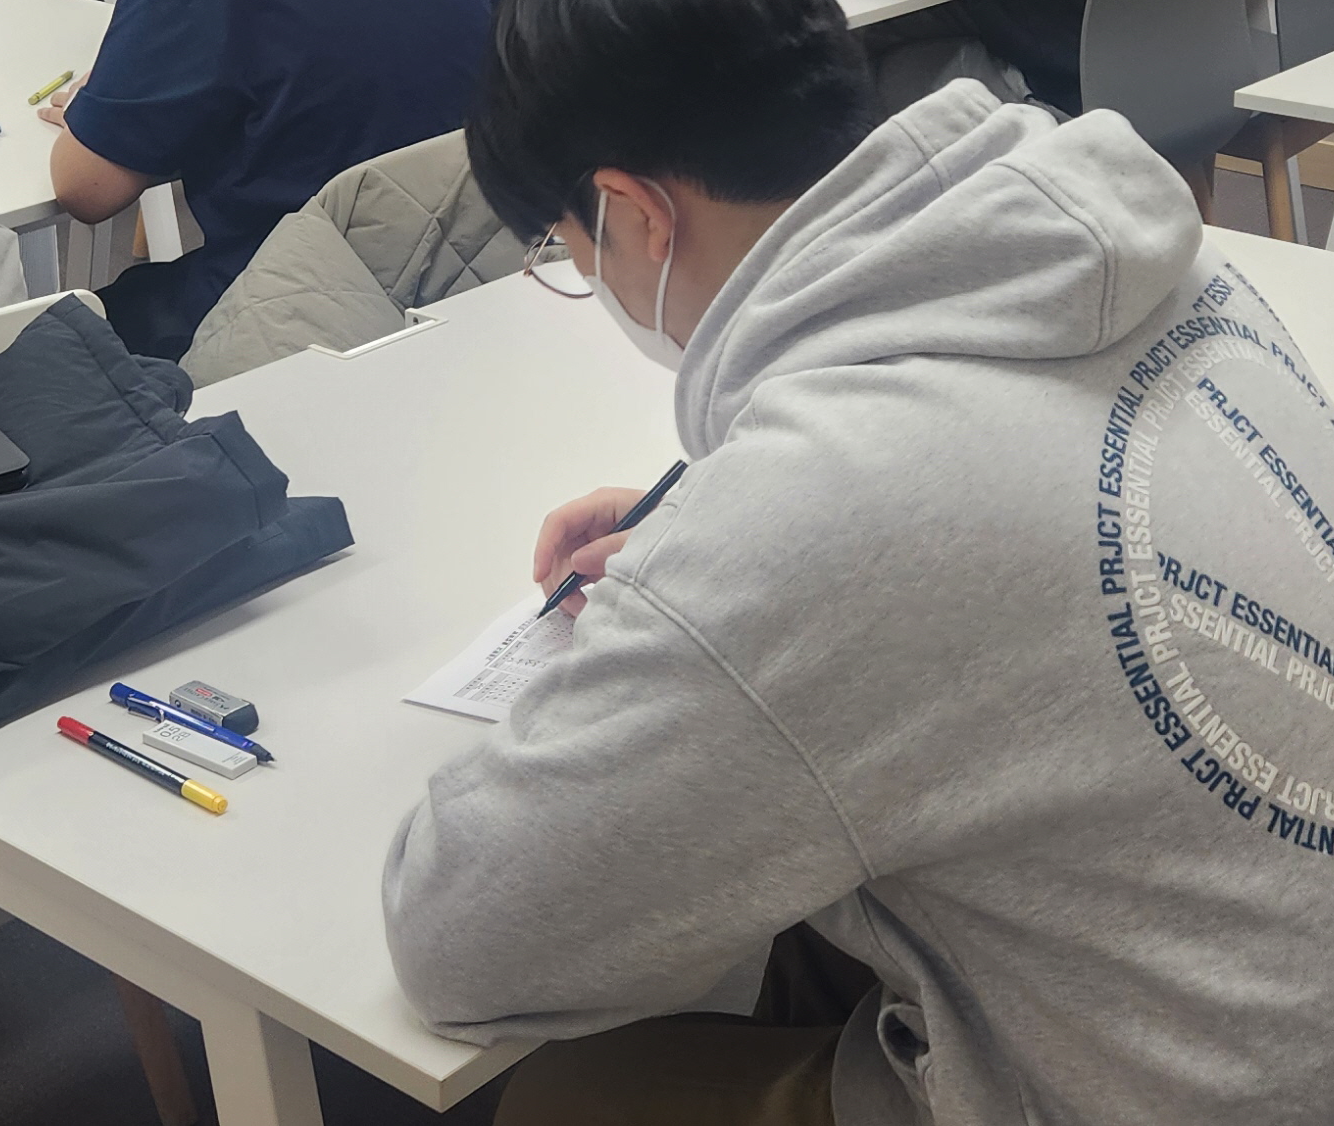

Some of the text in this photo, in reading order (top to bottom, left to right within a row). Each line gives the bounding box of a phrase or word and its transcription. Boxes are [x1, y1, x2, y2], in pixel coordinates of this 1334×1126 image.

[1130, 339, 1177, 390] PRJCT
[1166, 316, 1268, 351] ESSENTIAL
[1271, 341, 1329, 410] PRJCT
[1099, 386, 1145, 498] ESSENTIAL
[1142, 370, 1186, 432] PRJCT
[1197, 377, 1263, 443] PRJCT
[1126, 428, 1159, 560] ESSENTIAL
[1184, 390, 1283, 508] ESSENTIAL
[1097, 501, 1127, 595] PRJCT
[1131, 570, 1180, 665] PRJCT
[1107, 602, 1192, 752] ESSENTIAL
[1166, 661, 1278, 793] ESSENTIAL
[1181, 748, 1262, 821] PRJCT
